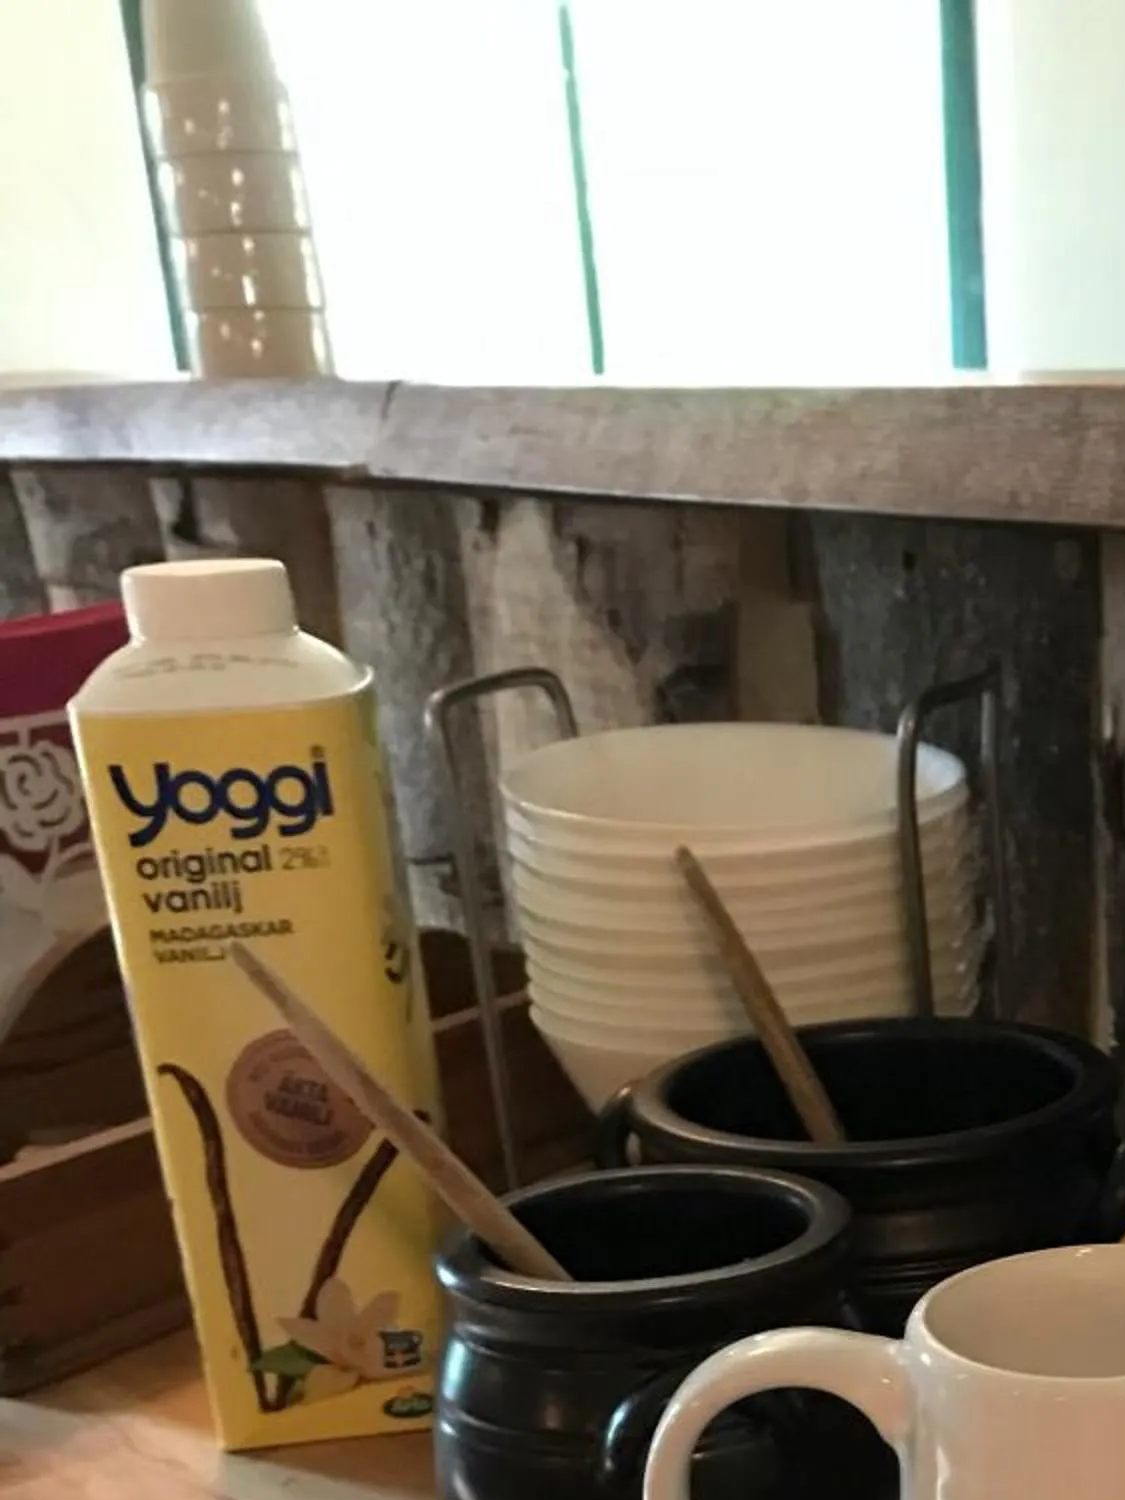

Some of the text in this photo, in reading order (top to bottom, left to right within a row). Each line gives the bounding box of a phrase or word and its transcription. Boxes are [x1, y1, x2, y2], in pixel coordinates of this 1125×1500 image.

[108, 758, 335, 847] yoggi
[136, 844, 272, 883] original
[142, 880, 243, 914] vanilj
[149, 919, 294, 944] MADAGASKAR
[153, 946, 226, 965] VANILJ
